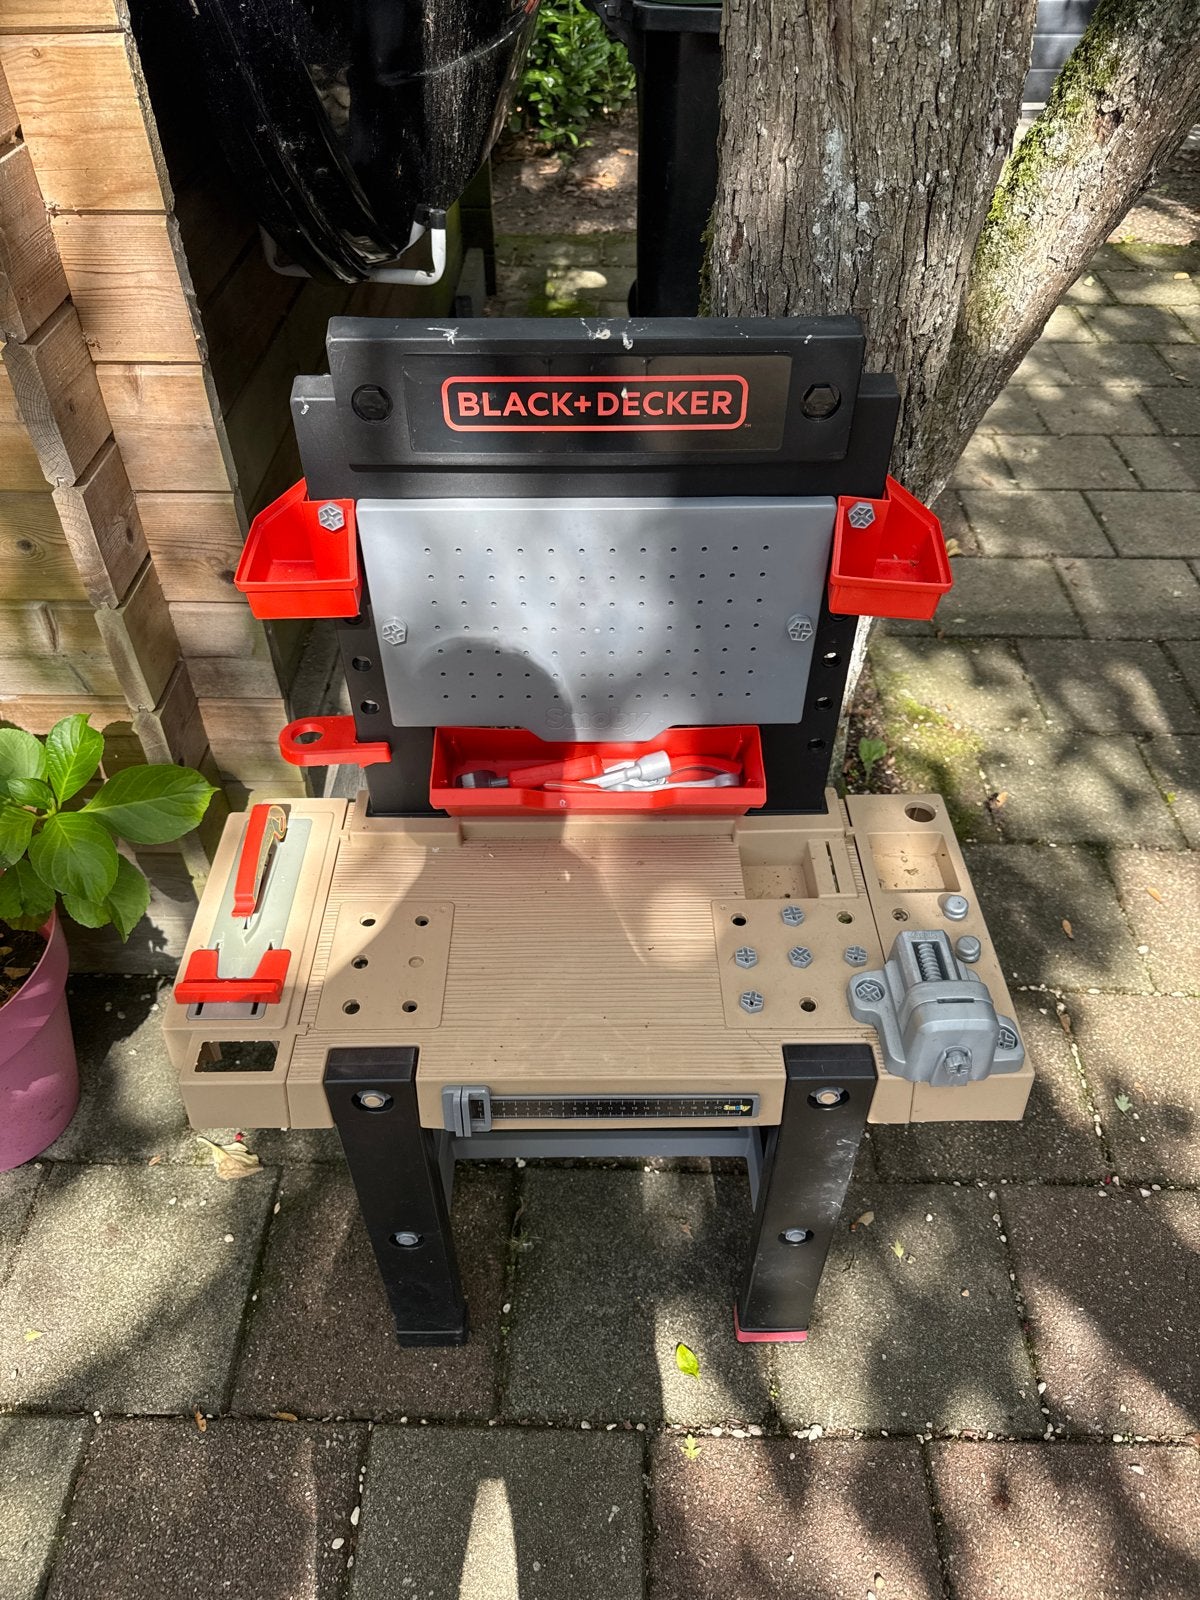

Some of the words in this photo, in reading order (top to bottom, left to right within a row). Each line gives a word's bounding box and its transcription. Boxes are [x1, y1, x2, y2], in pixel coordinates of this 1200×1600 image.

[457, 391, 733, 417] BLACK+DECKER
[545, 706, 651, 737] Smoby
[723, 1104, 751, 1112] Smoby
